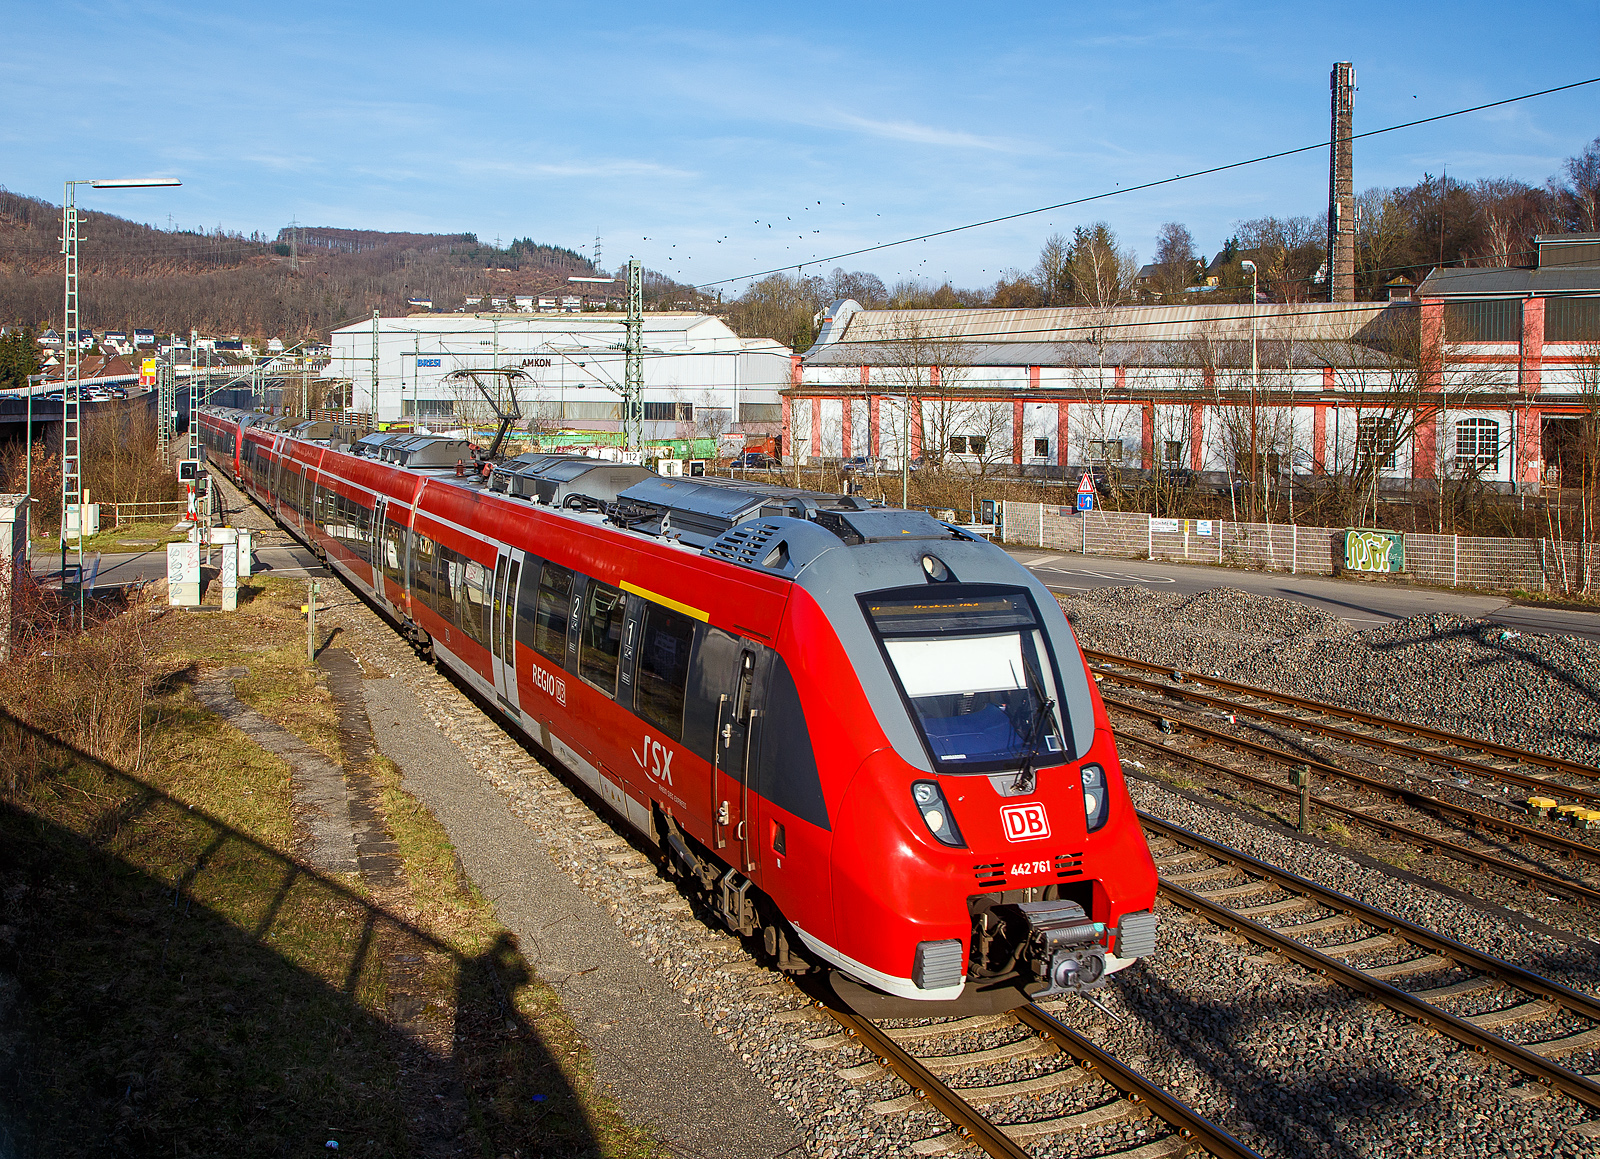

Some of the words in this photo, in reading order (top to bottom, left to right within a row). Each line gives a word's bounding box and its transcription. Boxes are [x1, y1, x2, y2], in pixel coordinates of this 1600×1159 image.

[417, 358, 441, 368] BRESI
[522, 358, 551, 368] AMKON
[625, 452, 638, 461] 112
[573, 597, 580, 618] 2
[532, 663, 555, 697] REGIO
[556, 678, 566, 706] DB
[1004, 805, 1046, 838] DB
[1010, 861, 1031, 875] 442
[1032, 859, 1051, 874] 761
